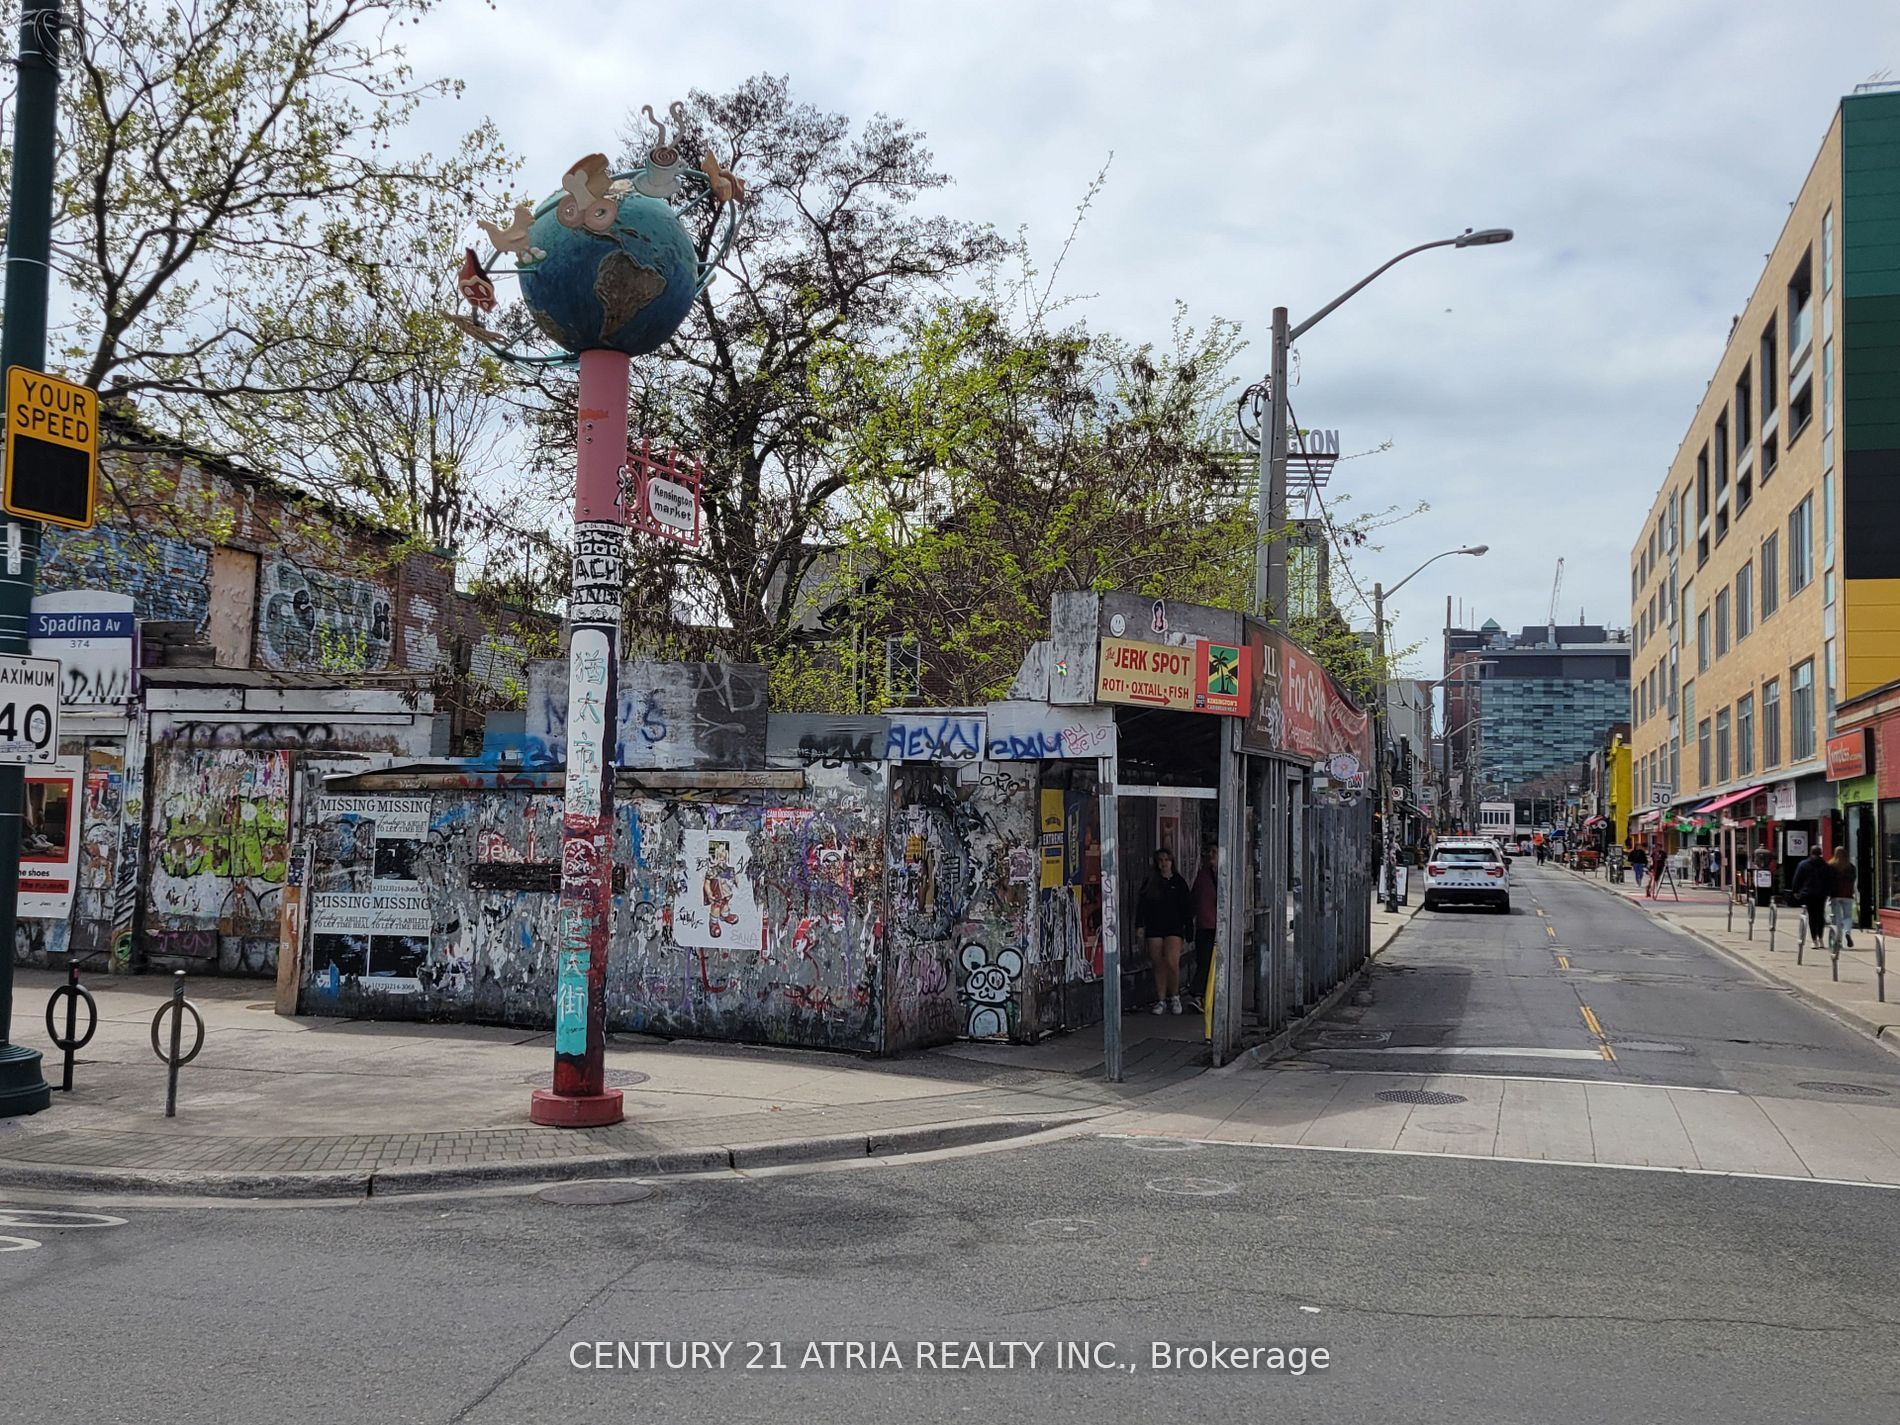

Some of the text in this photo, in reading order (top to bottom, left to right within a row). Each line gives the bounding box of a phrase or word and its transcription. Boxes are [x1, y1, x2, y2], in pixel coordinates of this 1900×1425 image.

[22, 377, 86, 418] YOUR
[16, 404, 89, 443] SPEED
[654, 484, 693, 508] Kensington
[654, 502, 691, 521] market
[39, 615, 121, 635] Spadina Av
[70, 640, 90, 648] 374
[1104, 646, 1191, 676] The JERK SPOT
[0, 668, 55, 687] AXIMUM
[1102, 678, 1189, 700] ROTI OXTAIL FISH
[1288, 657, 1306, 714] For
[1307, 670, 1326, 725] Sale
[0, 703, 52, 749] 40
[320, 799, 375, 812] MISSING
[1652, 793, 1670, 804] 30
[28, 867, 50, 877] shoes
[314, 895, 431, 911] MISSING MISSING
